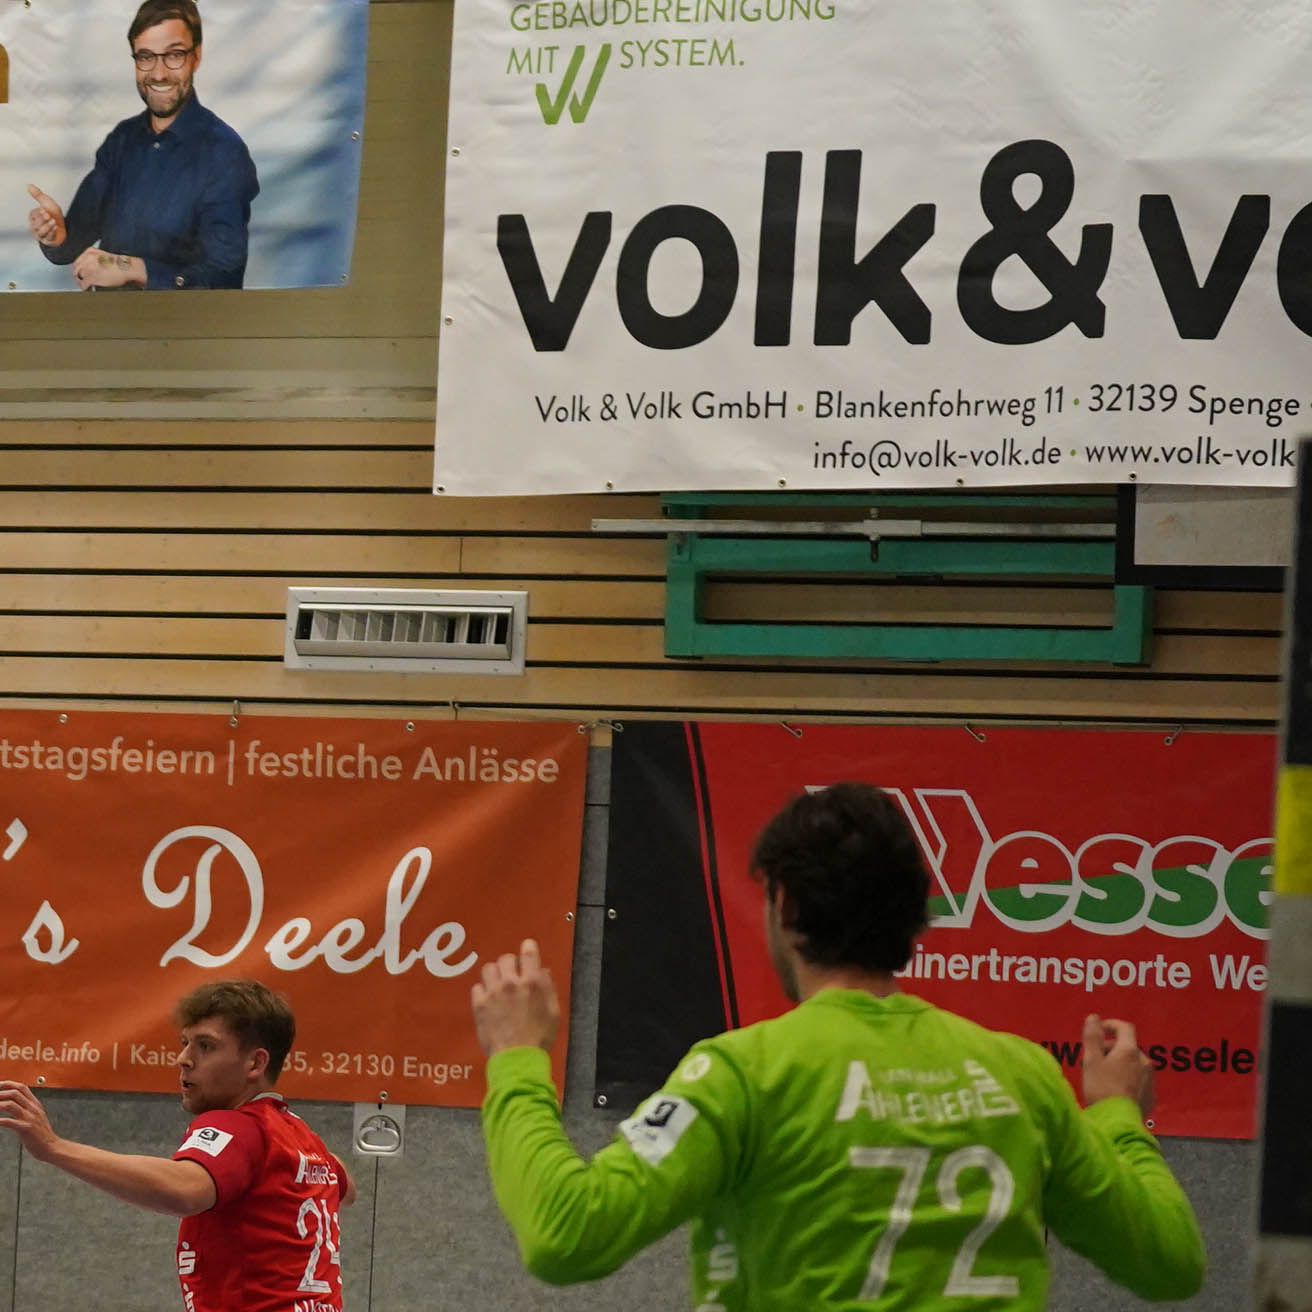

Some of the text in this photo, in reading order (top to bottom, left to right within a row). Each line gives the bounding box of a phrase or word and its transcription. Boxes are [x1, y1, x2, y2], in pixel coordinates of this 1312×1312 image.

[506, 46, 559, 74] MIT
[620, 39, 745, 69] SYSTEM.
[536, 383, 1300, 427] Volk & Volk GmbH Blankenfohrweg 11 32139 Spenge
[814, 437, 1061, 477] info@volk-volk.de
[244, 739, 403, 781] festliche
[412, 745, 560, 784] Anlässe
[141, 823, 479, 980] Deele
[320, 1053, 395, 1077] 32130
[403, 1056, 473, 1085] Enger
[848, 1145, 1020, 1300] 72
